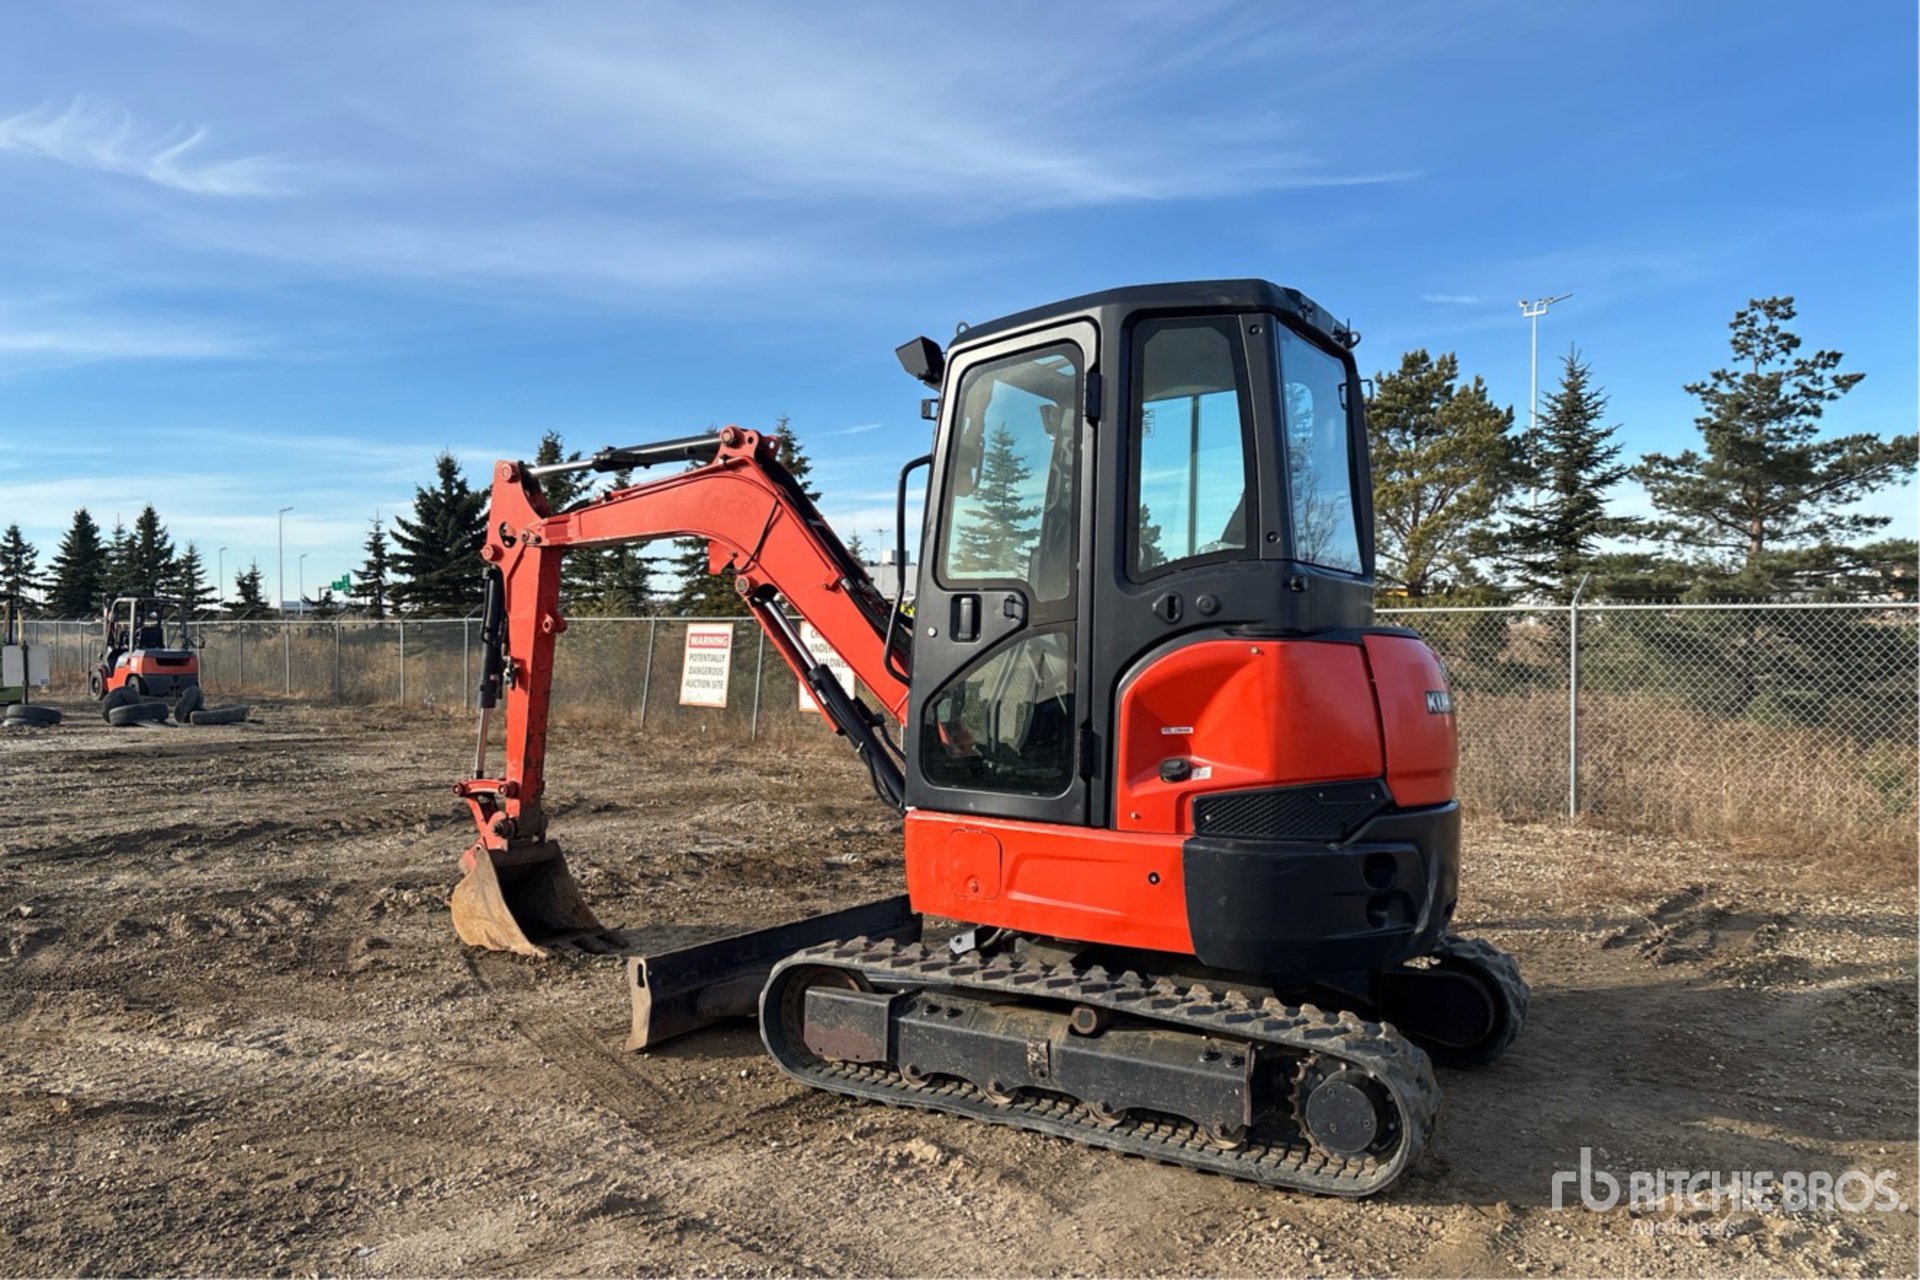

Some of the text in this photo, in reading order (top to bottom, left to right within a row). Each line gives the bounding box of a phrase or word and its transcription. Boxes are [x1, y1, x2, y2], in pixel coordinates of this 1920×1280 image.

[690, 635, 728, 647] WARNING
[689, 653, 725, 663] POTENTIALLY
[688, 666, 723, 677] DANGEROUS
[685, 678, 724, 690] AUCTION SITE
